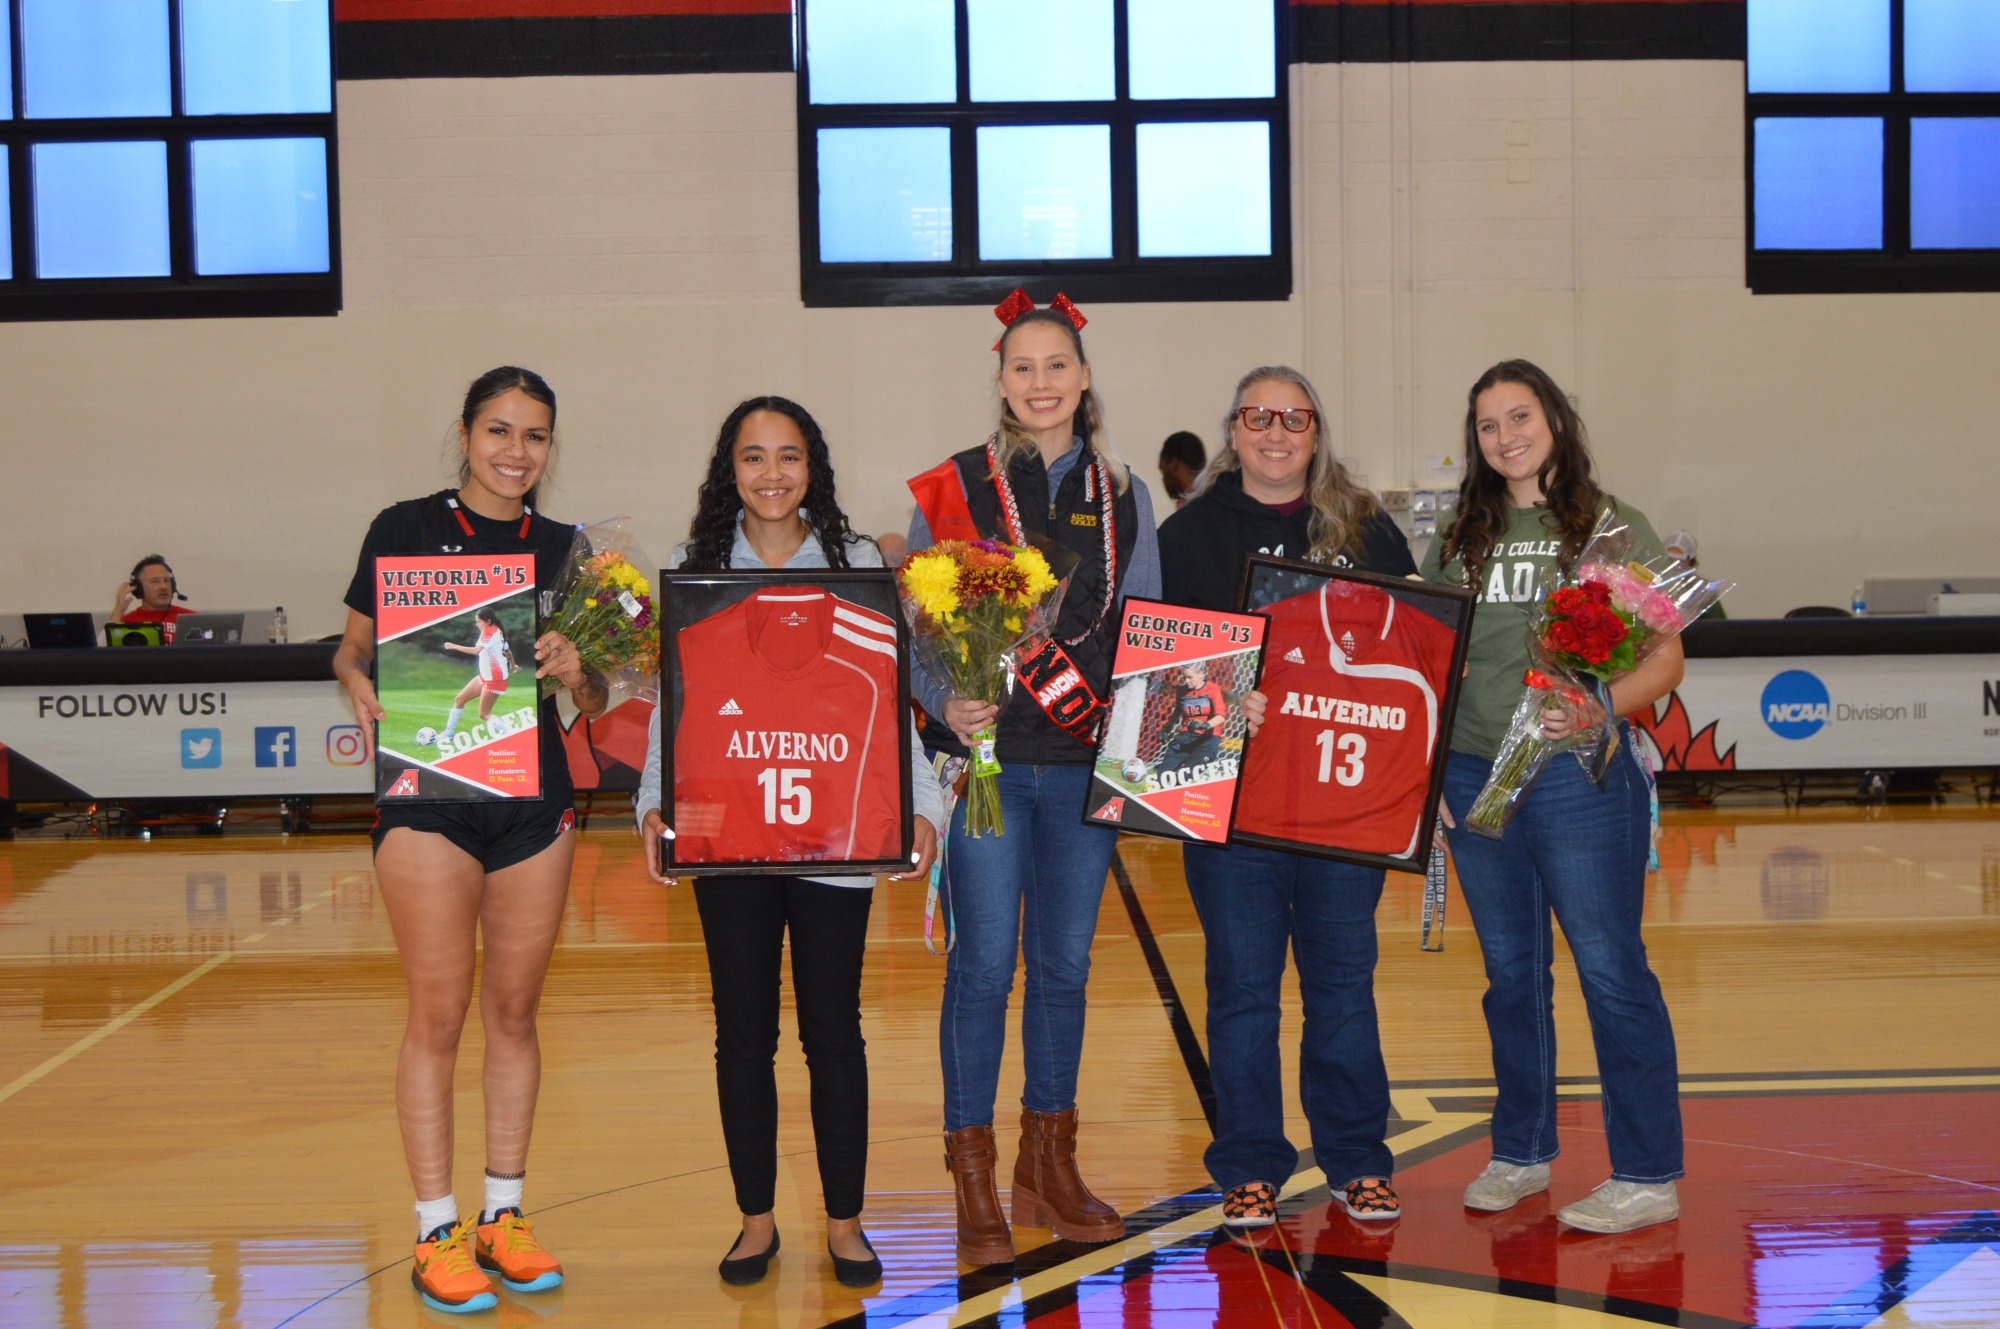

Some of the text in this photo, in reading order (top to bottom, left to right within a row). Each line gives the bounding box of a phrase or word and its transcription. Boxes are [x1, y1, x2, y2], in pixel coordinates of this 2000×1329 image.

[1508, 541, 1562, 557] COLLE
[381, 565, 527, 587] VICTORIA #15
[382, 590, 459, 607] PARRA
[1127, 613, 1251, 644] GEORGIA #13
[1125, 631, 1175, 652] WISE
[1283, 654, 1306, 665] adidas
[38, 692, 227, 718] FOLLOW US!
[718, 708, 743, 716] adidas
[1280, 691, 1406, 731] ALVERNO
[1767, 702, 1927, 723] NCAA Division III
[437, 706, 538, 760] SOCCER
[726, 730, 849, 763] ALVERNO
[1316, 729, 1367, 787] 13
[1145, 758, 1239, 793] SOCCER
[757, 768, 812, 825] 15
[1183, 790, 1211, 801] Position:
